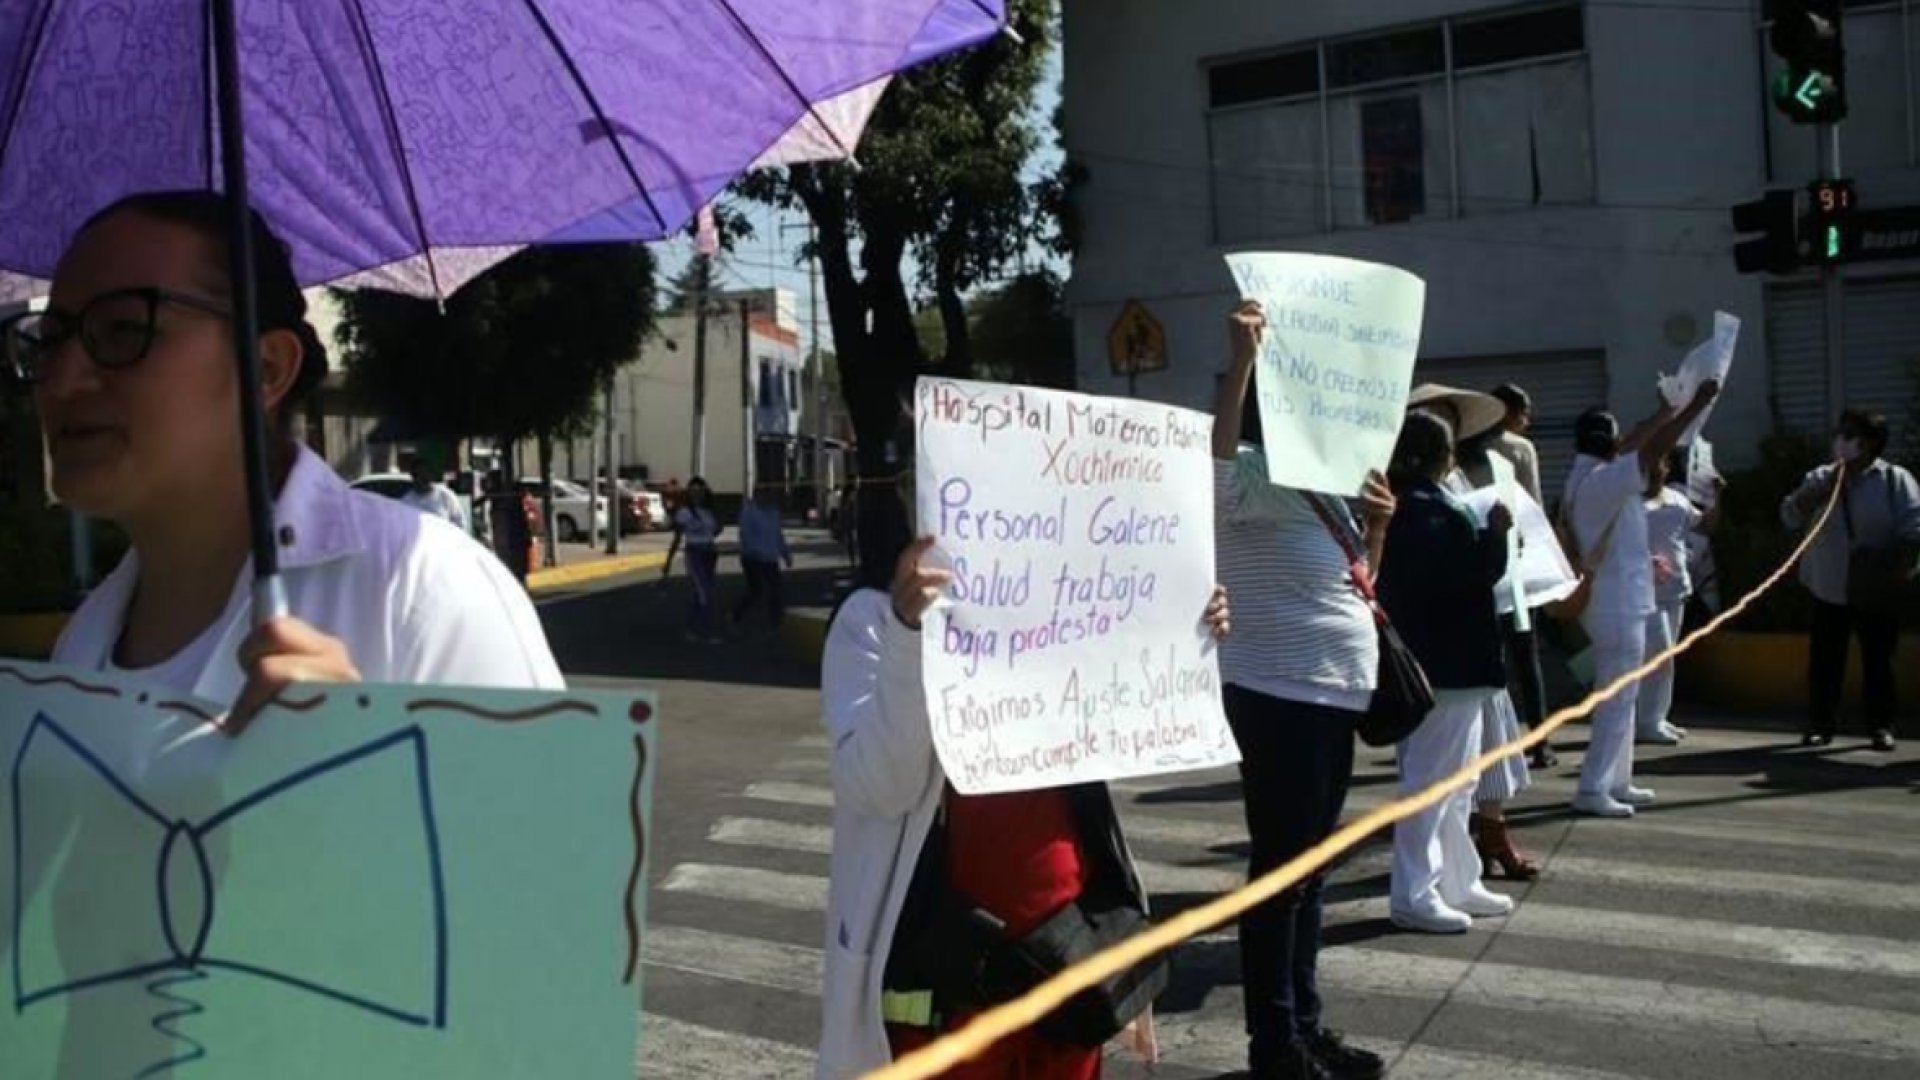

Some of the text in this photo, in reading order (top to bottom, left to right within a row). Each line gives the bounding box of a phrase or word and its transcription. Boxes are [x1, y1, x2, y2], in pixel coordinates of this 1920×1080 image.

[1819, 187, 1848, 211] 91
[1289, 349, 1319, 386] NO
[932, 383, 1051, 444] Hospital
[938, 475, 1068, 546] Personal
[950, 554, 1157, 621] Salud trabaja
[943, 605, 1113, 678] baja protesta
[940, 684, 1047, 752] Exigimos
